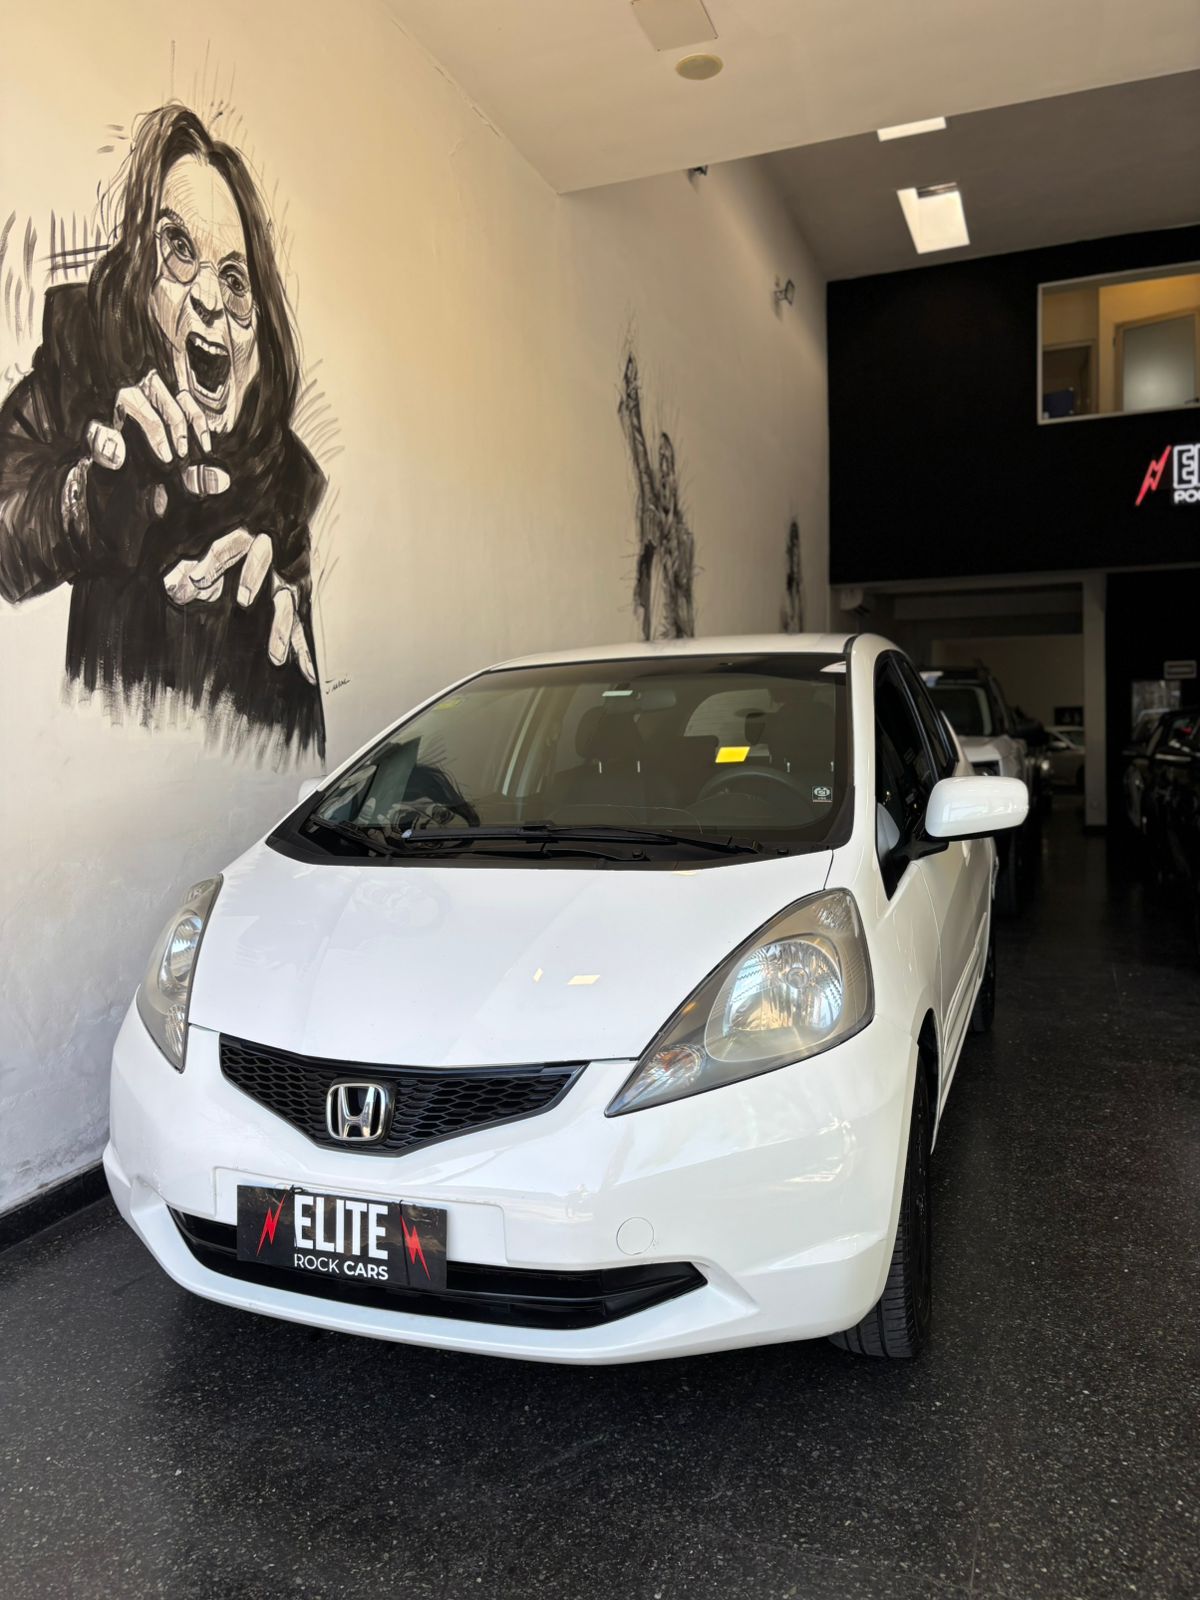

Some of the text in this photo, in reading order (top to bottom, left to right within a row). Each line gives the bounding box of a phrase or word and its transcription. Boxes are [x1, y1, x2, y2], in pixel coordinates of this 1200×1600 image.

[294, 1195, 389, 1260] ELITE
[294, 1253, 389, 1280] ROCK CARS
